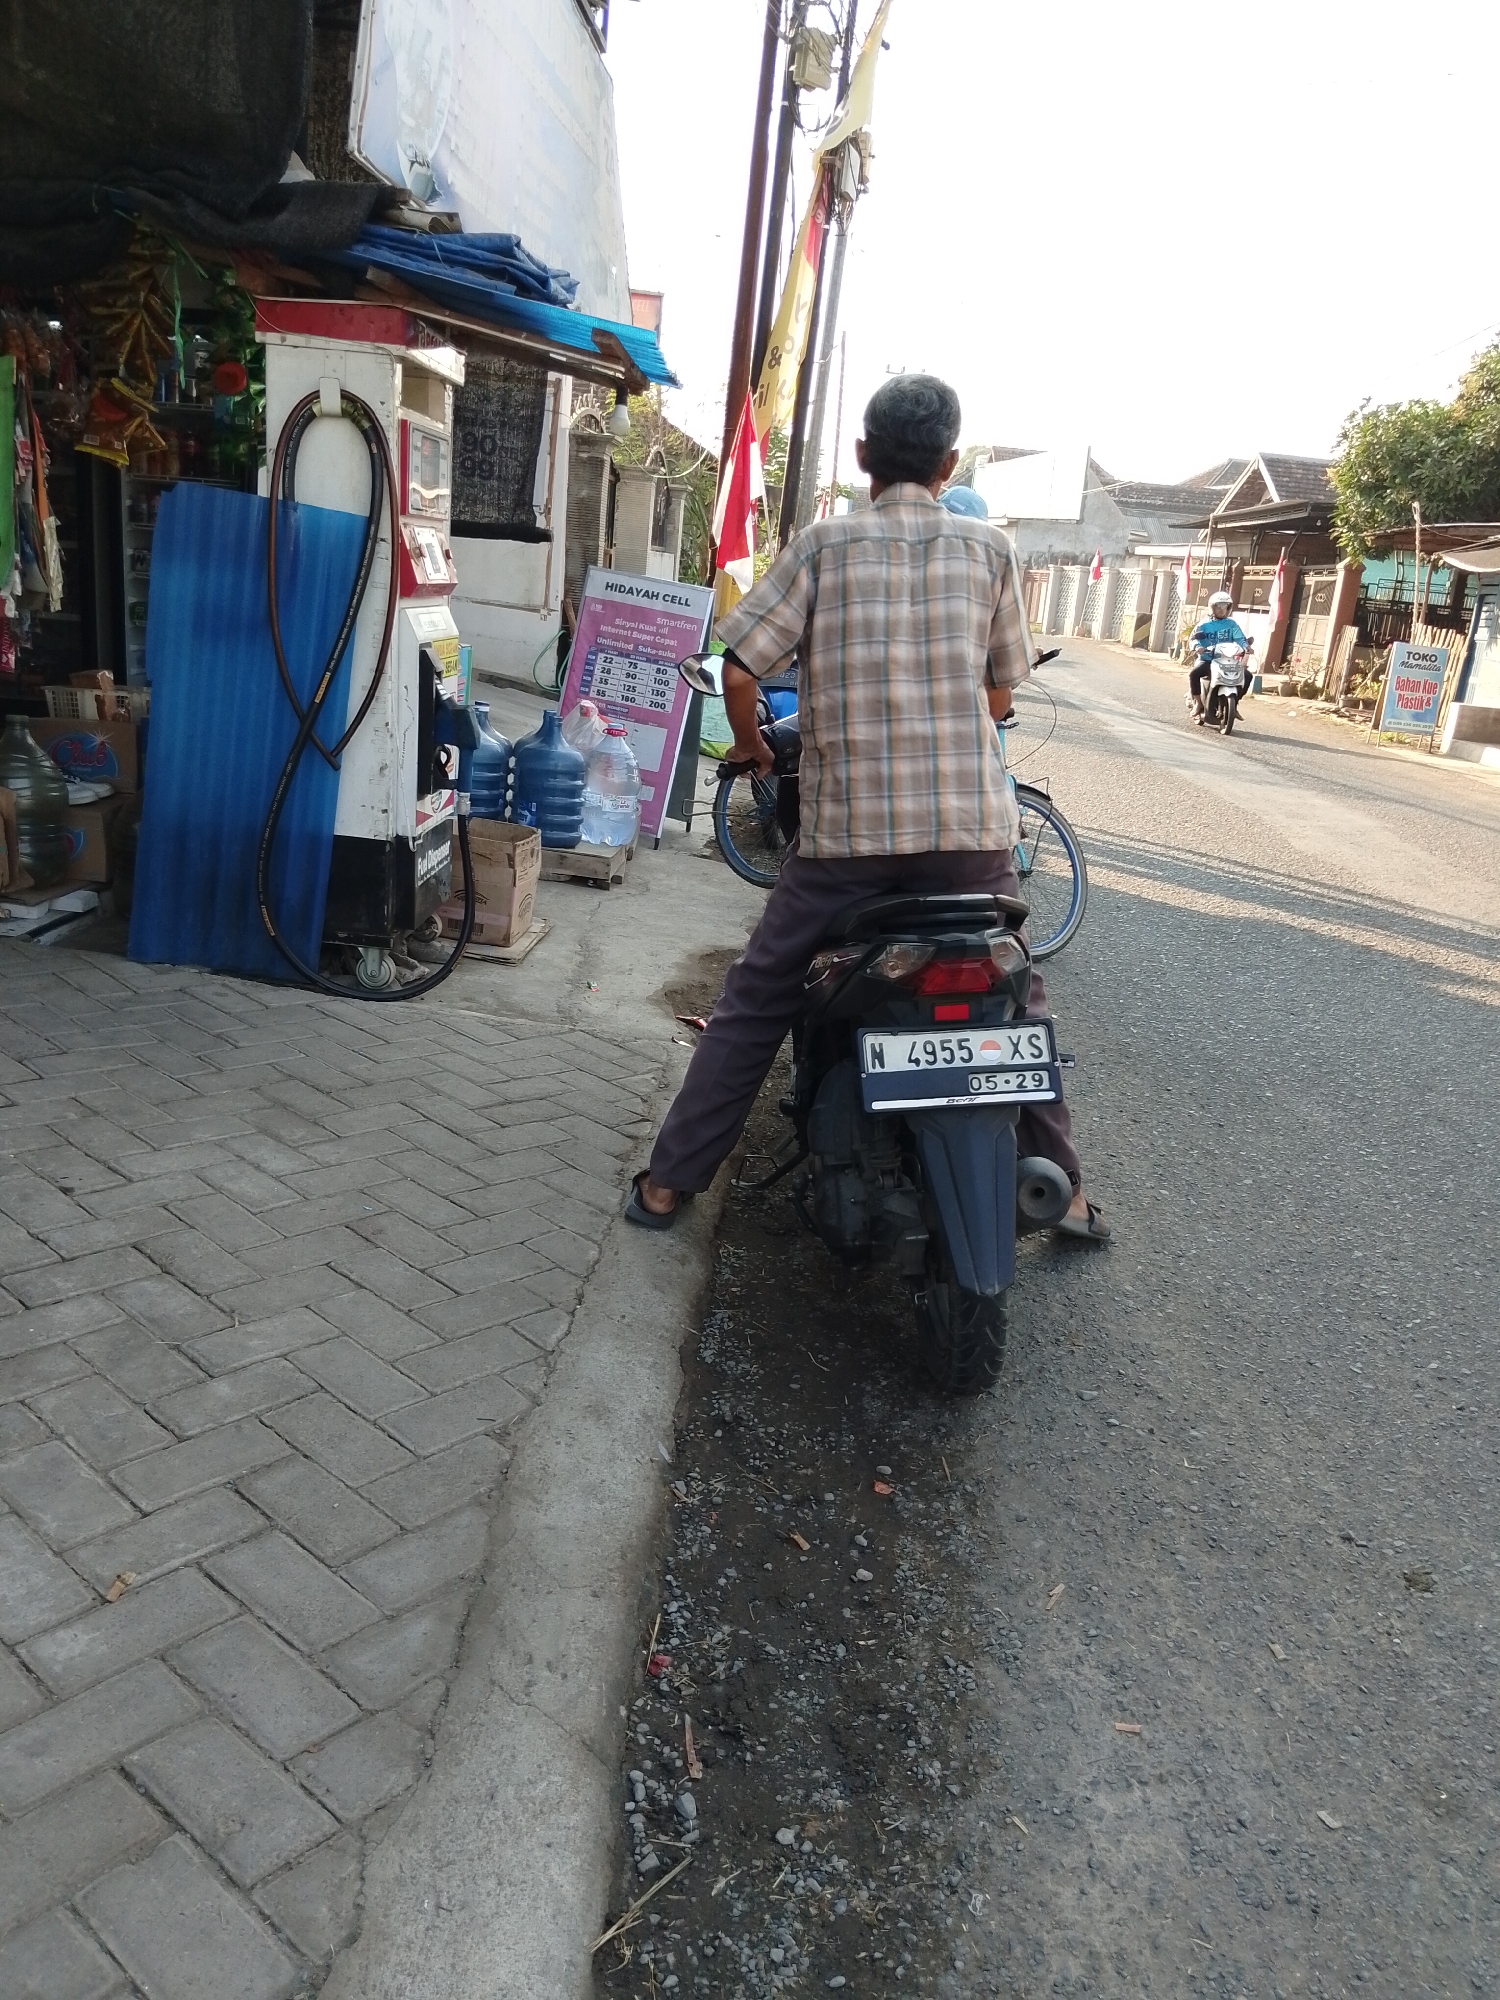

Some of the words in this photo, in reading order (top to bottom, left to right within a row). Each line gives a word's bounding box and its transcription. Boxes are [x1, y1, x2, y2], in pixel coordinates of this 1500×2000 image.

[604, 581, 660, 601] HIDAYAH
[662, 593, 692, 607] CELL
[614, 618, 638, 629] Sinyal
[638, 622, 657, 633] Kuat
[656, 617, 697, 632] smartfren
[600, 624, 632, 636] Internet
[632, 631, 654, 642] Super
[655, 636, 678, 647] Cepat
[596, 636, 634, 650] Unlimited
[637, 645, 676, 659] Suka-suka
[602, 656, 614, 665] 22
[1406, 650, 1438, 663] TOKO
[627, 661, 639, 669] 75
[1399, 660, 1442, 672] Mamalita
[600, 667, 612, 675] 28
[625, 672, 637, 680] 90
[655, 667, 668, 676] 80
[598, 677, 609, 685] 35
[653, 677, 670, 687] 100
[1394, 675, 1422, 693] Bahan
[1421, 679, 1438, 696] Kue
[595, 689, 607, 697] 55
[622, 684, 637, 693] 125
[650, 689, 666, 698] 130
[620, 694, 636, 703] 180
[1396, 693, 1425, 711] Plastik
[1424, 696, 1432, 708] &
[648, 700, 666, 710] 200
[50, 739, 107, 767] Club
[417, 851, 429, 878] Fuel
[428, 841, 450, 873] Dispenser
[870, 1042, 886, 1070] N
[907, 1037, 974, 1068] 4955
[1007, 1032, 1044, 1061] XS
